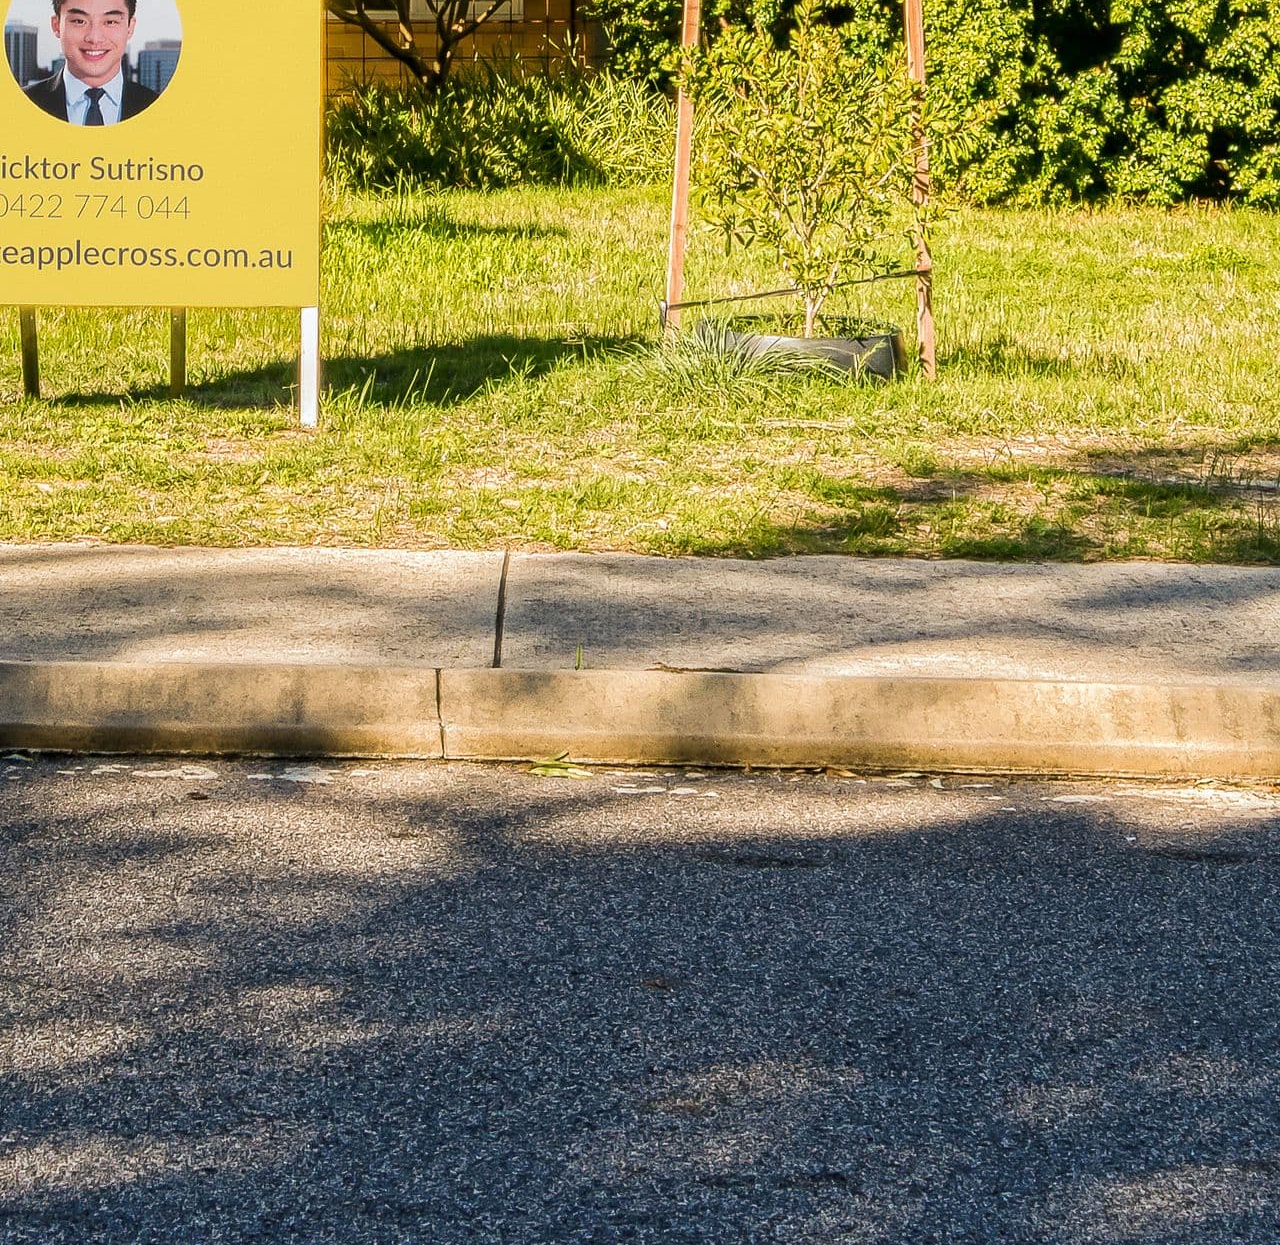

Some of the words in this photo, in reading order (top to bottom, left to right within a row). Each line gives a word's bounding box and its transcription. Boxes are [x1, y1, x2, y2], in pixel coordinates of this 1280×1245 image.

[89, 155, 205, 183] Sutrisno
[74, 193, 129, 221] 774
[136, 194, 192, 221] 044
